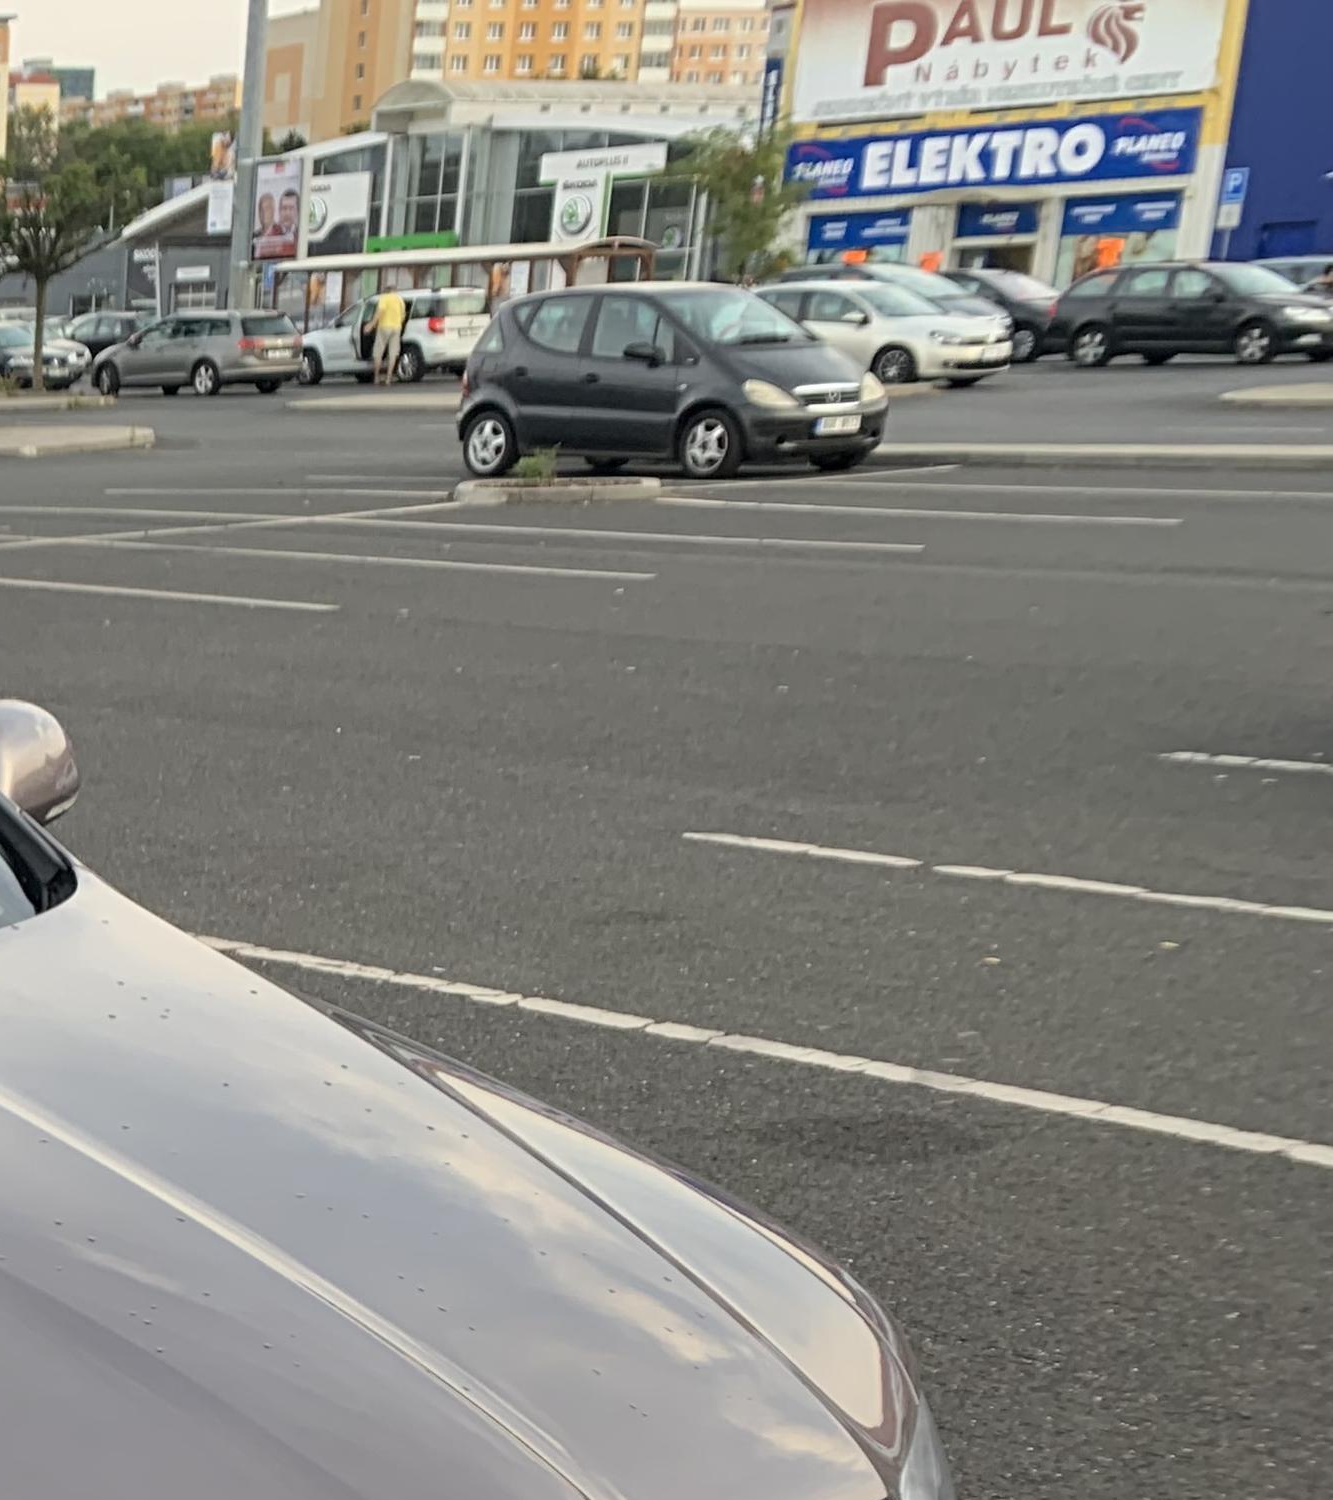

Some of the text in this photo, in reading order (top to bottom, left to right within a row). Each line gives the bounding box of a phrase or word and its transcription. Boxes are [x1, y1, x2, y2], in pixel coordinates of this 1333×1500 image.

[864, 0, 1072, 86] PAUL
[913, 47, 1100, 83] Nábytek
[859, 122, 1107, 191] ELEKTRO
[1228, 172, 1244, 193] P
